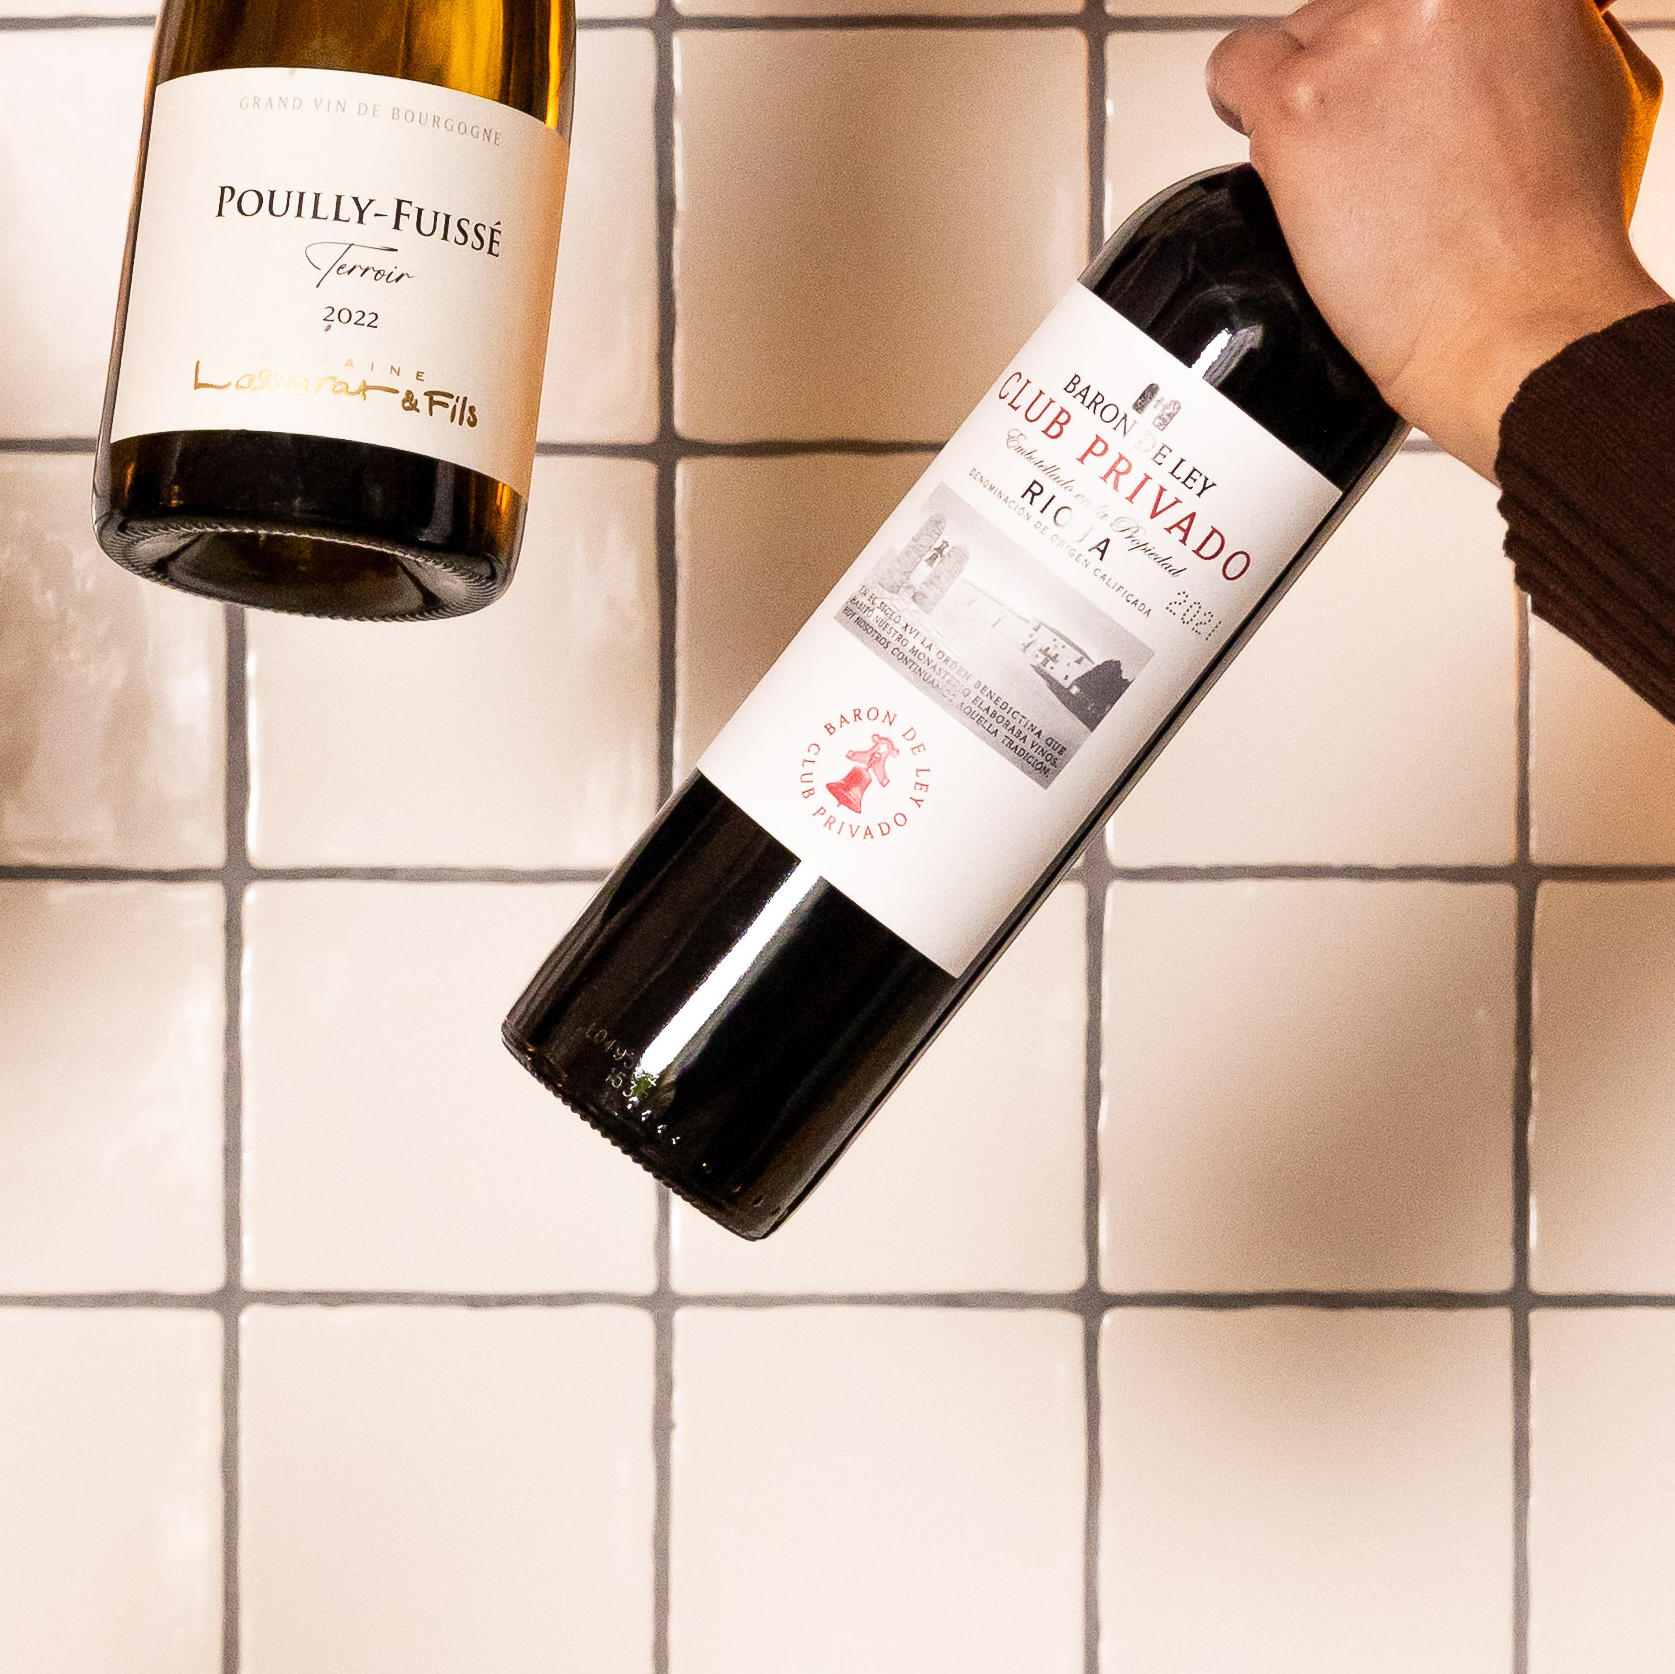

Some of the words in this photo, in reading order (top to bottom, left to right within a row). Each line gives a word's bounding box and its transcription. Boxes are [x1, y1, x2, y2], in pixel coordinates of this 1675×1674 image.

[238, 95, 303, 112] GRAND
[313, 96, 347, 113] VIN
[357, 102, 381, 118] DE
[390, 107, 503, 146] BOURGOGNE
[214, 184, 504, 258] POUILLY-FUISSÉ
[305, 241, 415, 289] Terroir
[322, 304, 379, 329] 2022
[423, 389, 478, 428] Fils
[1063, 373, 1139, 439] BARON
[1168, 457, 1218, 498] LEY
[998, 371, 1072, 441] CLUB
[1076, 433, 1251, 582] PRIVADO
[1006, 428, 1074, 493] Embotellado
[1110, 515, 1188, 578] Propiedad
[968, 467, 1032, 523] DENOMINACIÓN
[1033, 519, 1047, 536] DE
[1092, 567, 1152, 618] CALIFICADA
[1165, 590, 1222, 641] 2021
[855, 615, 891, 651] NOSOTROS
[957, 700, 1000, 739] AQUELLA
[874, 613, 909, 648] NUESTRO
[971, 694, 1028, 744] ELABORABA
[1029, 740, 1059, 769] VINOS.
[876, 597, 903, 625] SIGLO
[903, 621, 919, 640] XVI
[921, 637, 933, 653] LA
[936, 649, 973, 681] ORDEN
[974, 678, 1044, 740] BENEDICTINA
[1045, 736, 1068, 757] QUE
[823, 706, 898, 737] BARON
[901, 726, 926, 756] DE
[799, 742, 821, 800] CLUB
[812, 805, 908, 840] PRIVADO
[909, 767, 931, 809] LEY
